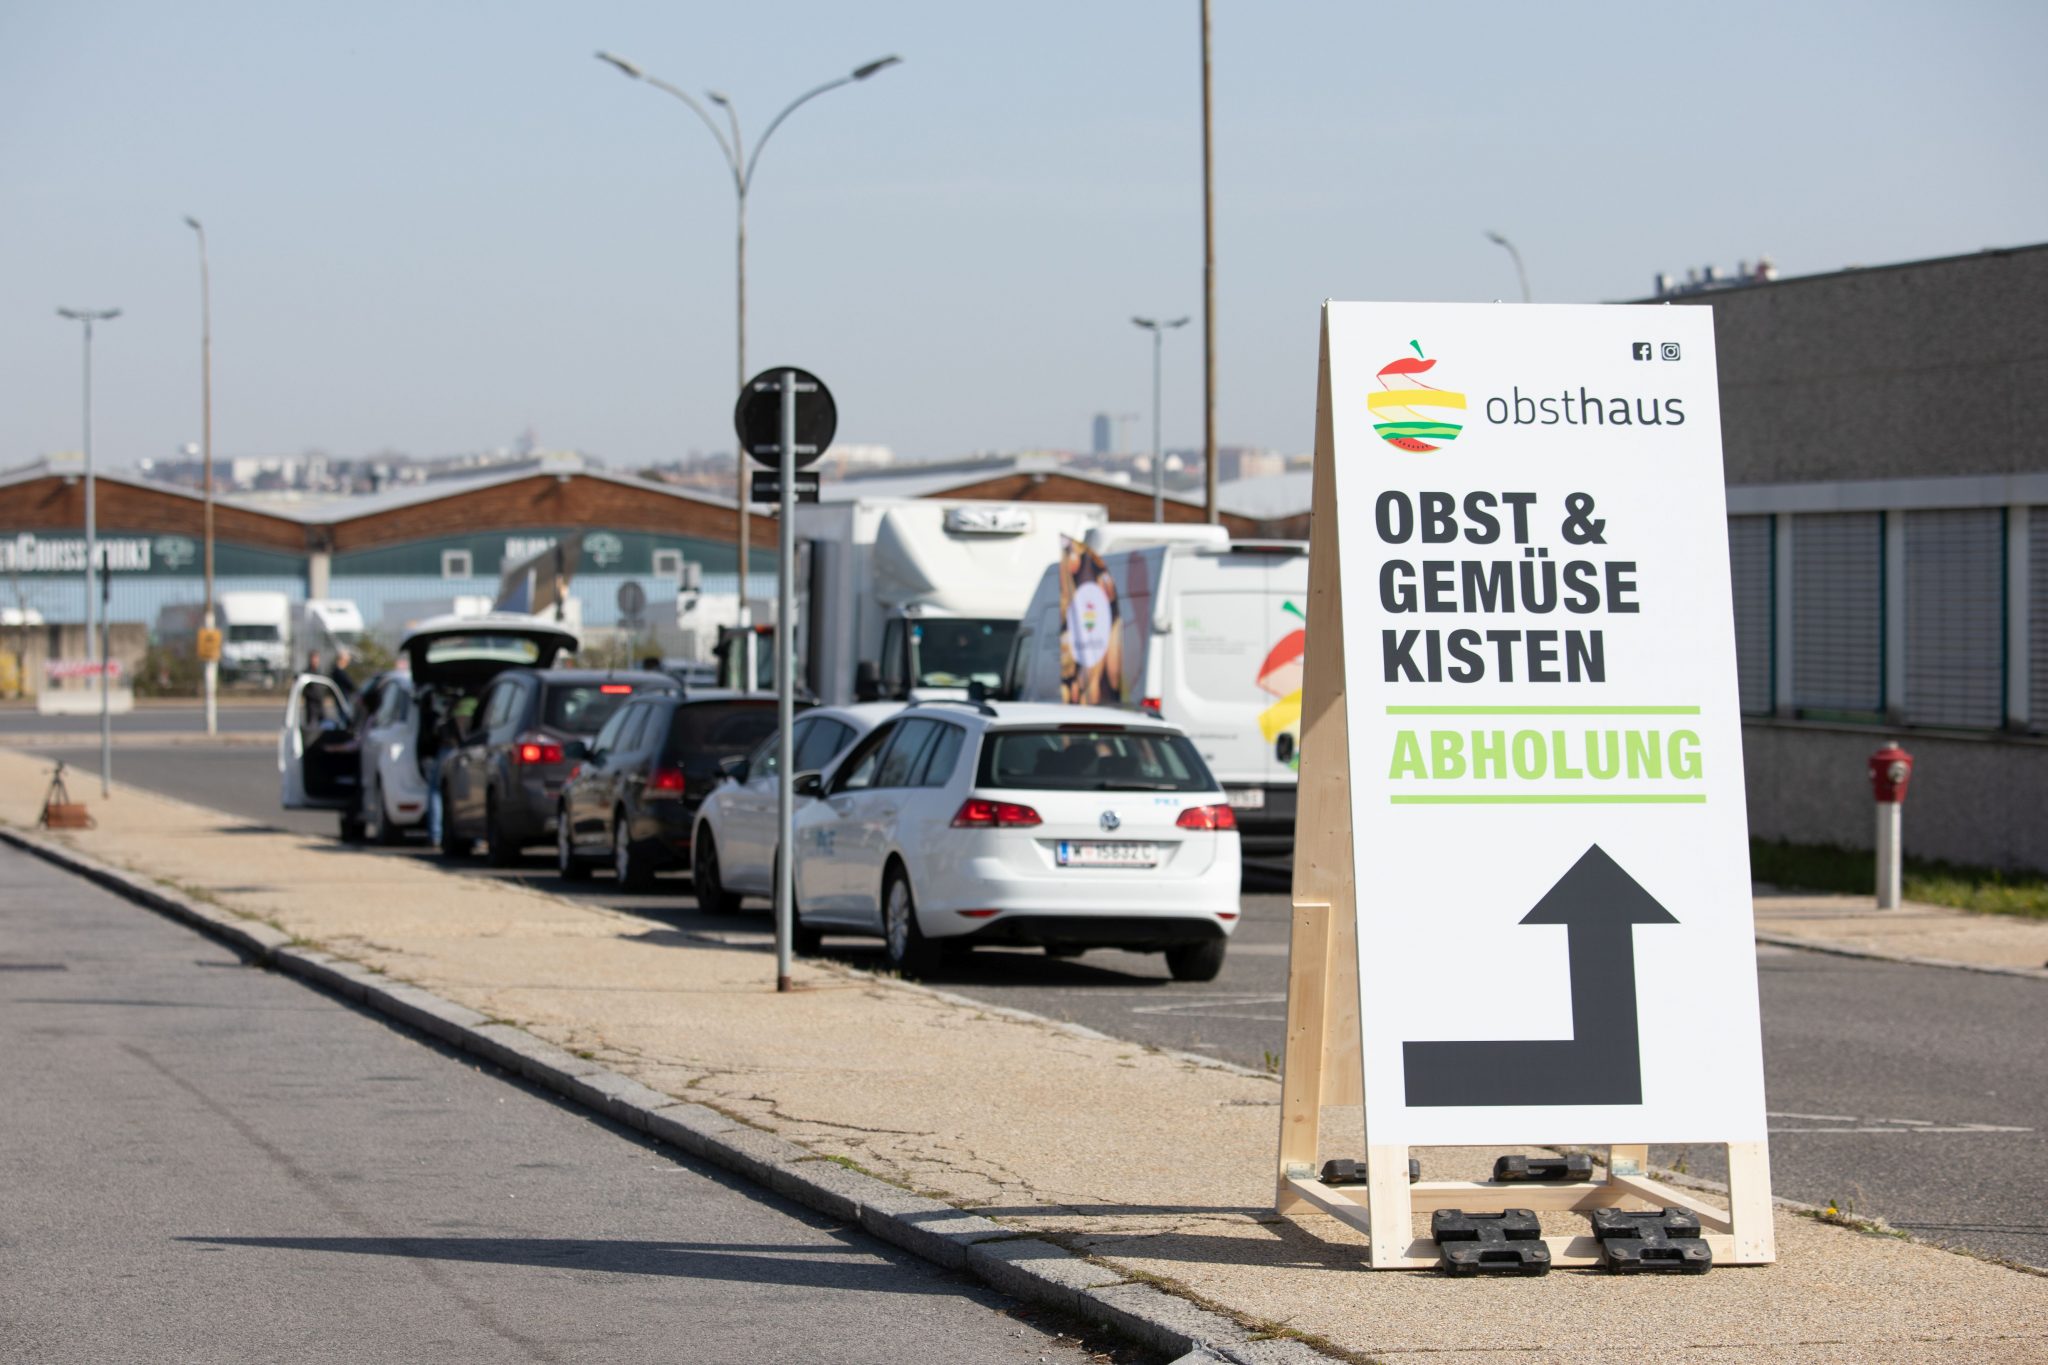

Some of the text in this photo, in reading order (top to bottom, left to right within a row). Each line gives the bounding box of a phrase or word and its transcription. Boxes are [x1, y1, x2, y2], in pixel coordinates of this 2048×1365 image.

[1487, 386, 1686, 426] obsthaus
[1375, 491, 1608, 547] OBST &
[1380, 548, 1641, 615] GEMÜSE
[1382, 630, 1607, 684] KISTEN
[1389, 729, 1704, 781] ABHOLUNG
